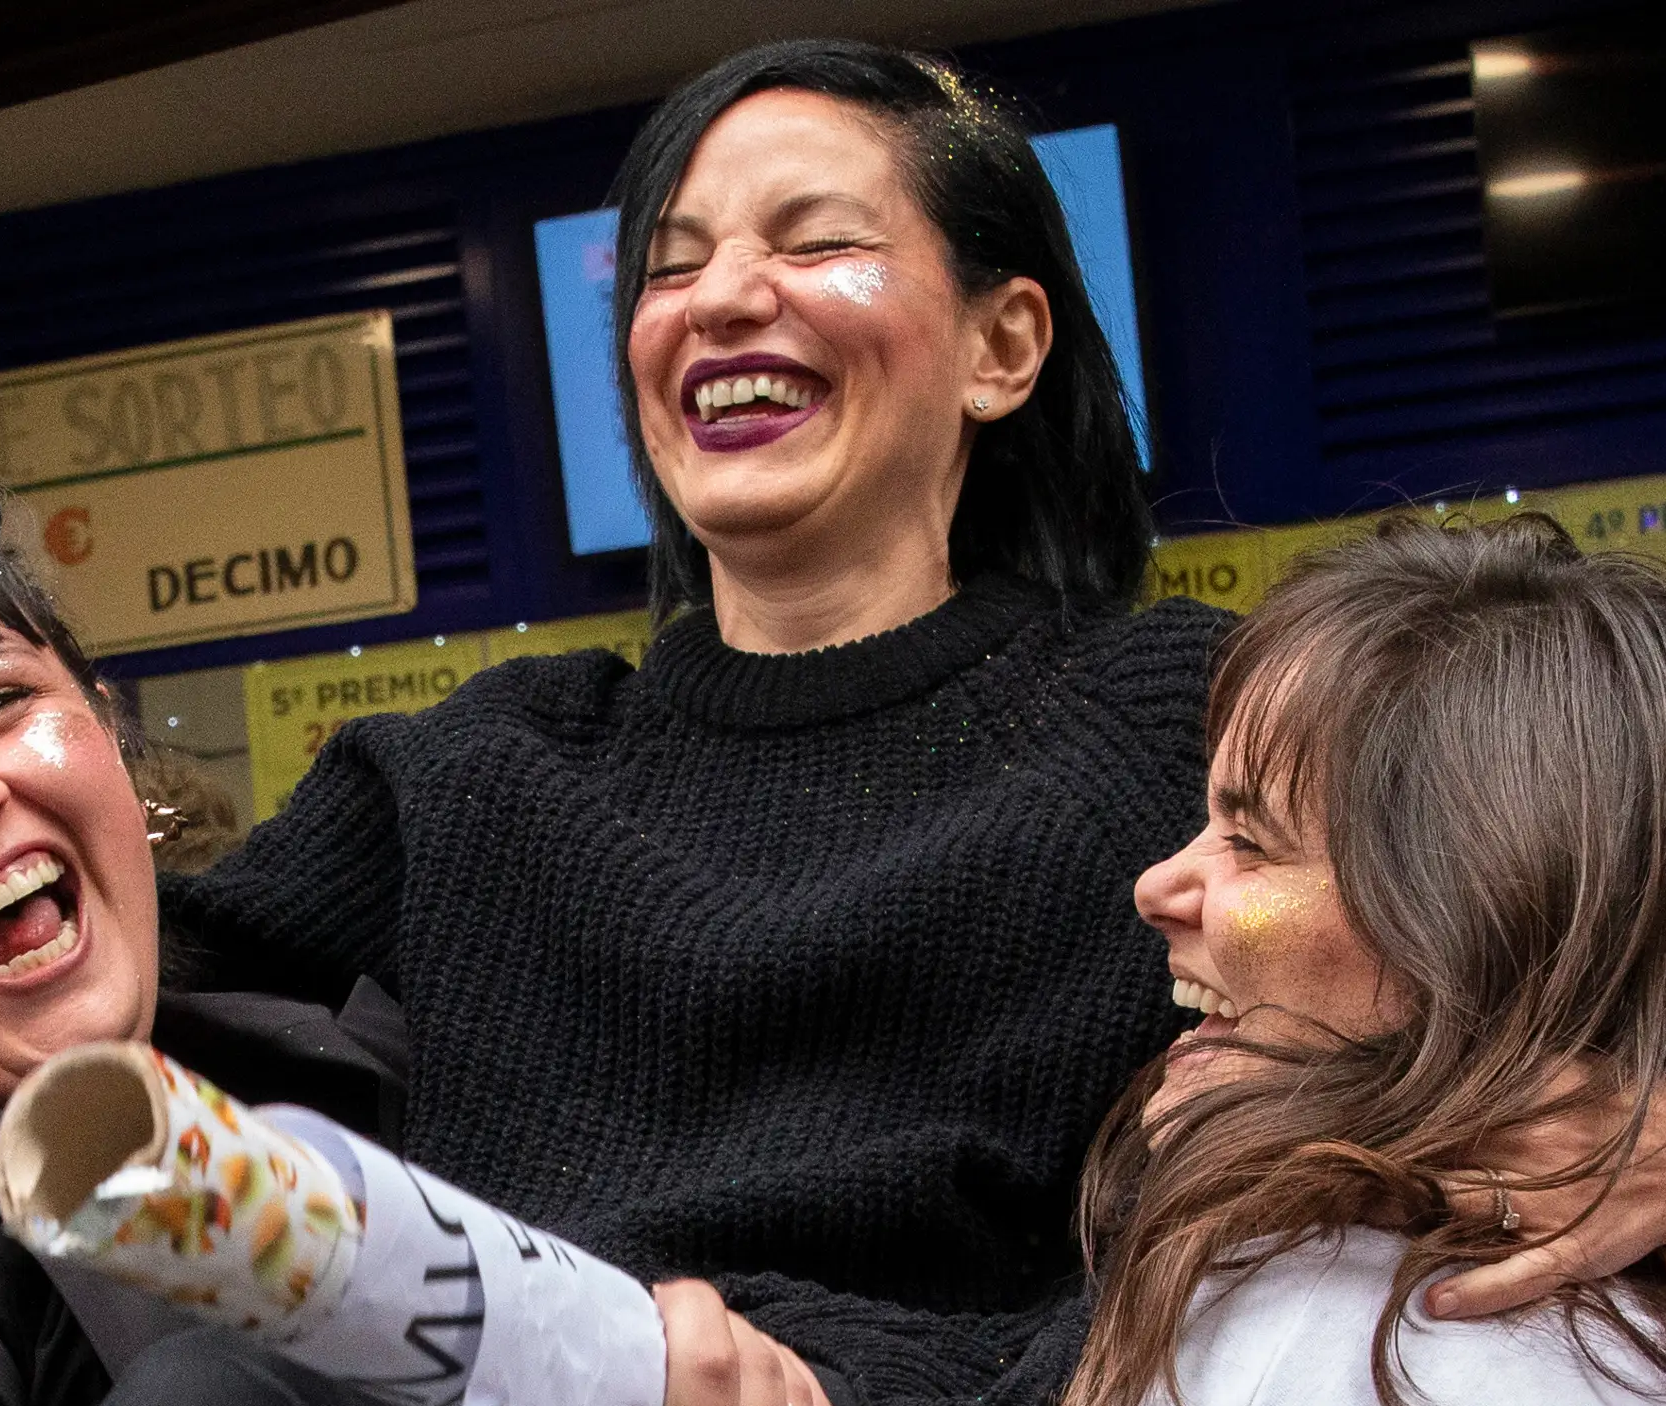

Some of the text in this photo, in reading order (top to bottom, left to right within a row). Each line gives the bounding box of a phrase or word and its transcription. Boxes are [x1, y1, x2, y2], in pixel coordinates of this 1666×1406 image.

[61, 342, 348, 468] SORTEO
[146, 536, 360, 614] DECIMO
[317, 667, 459, 712] PREMIO
